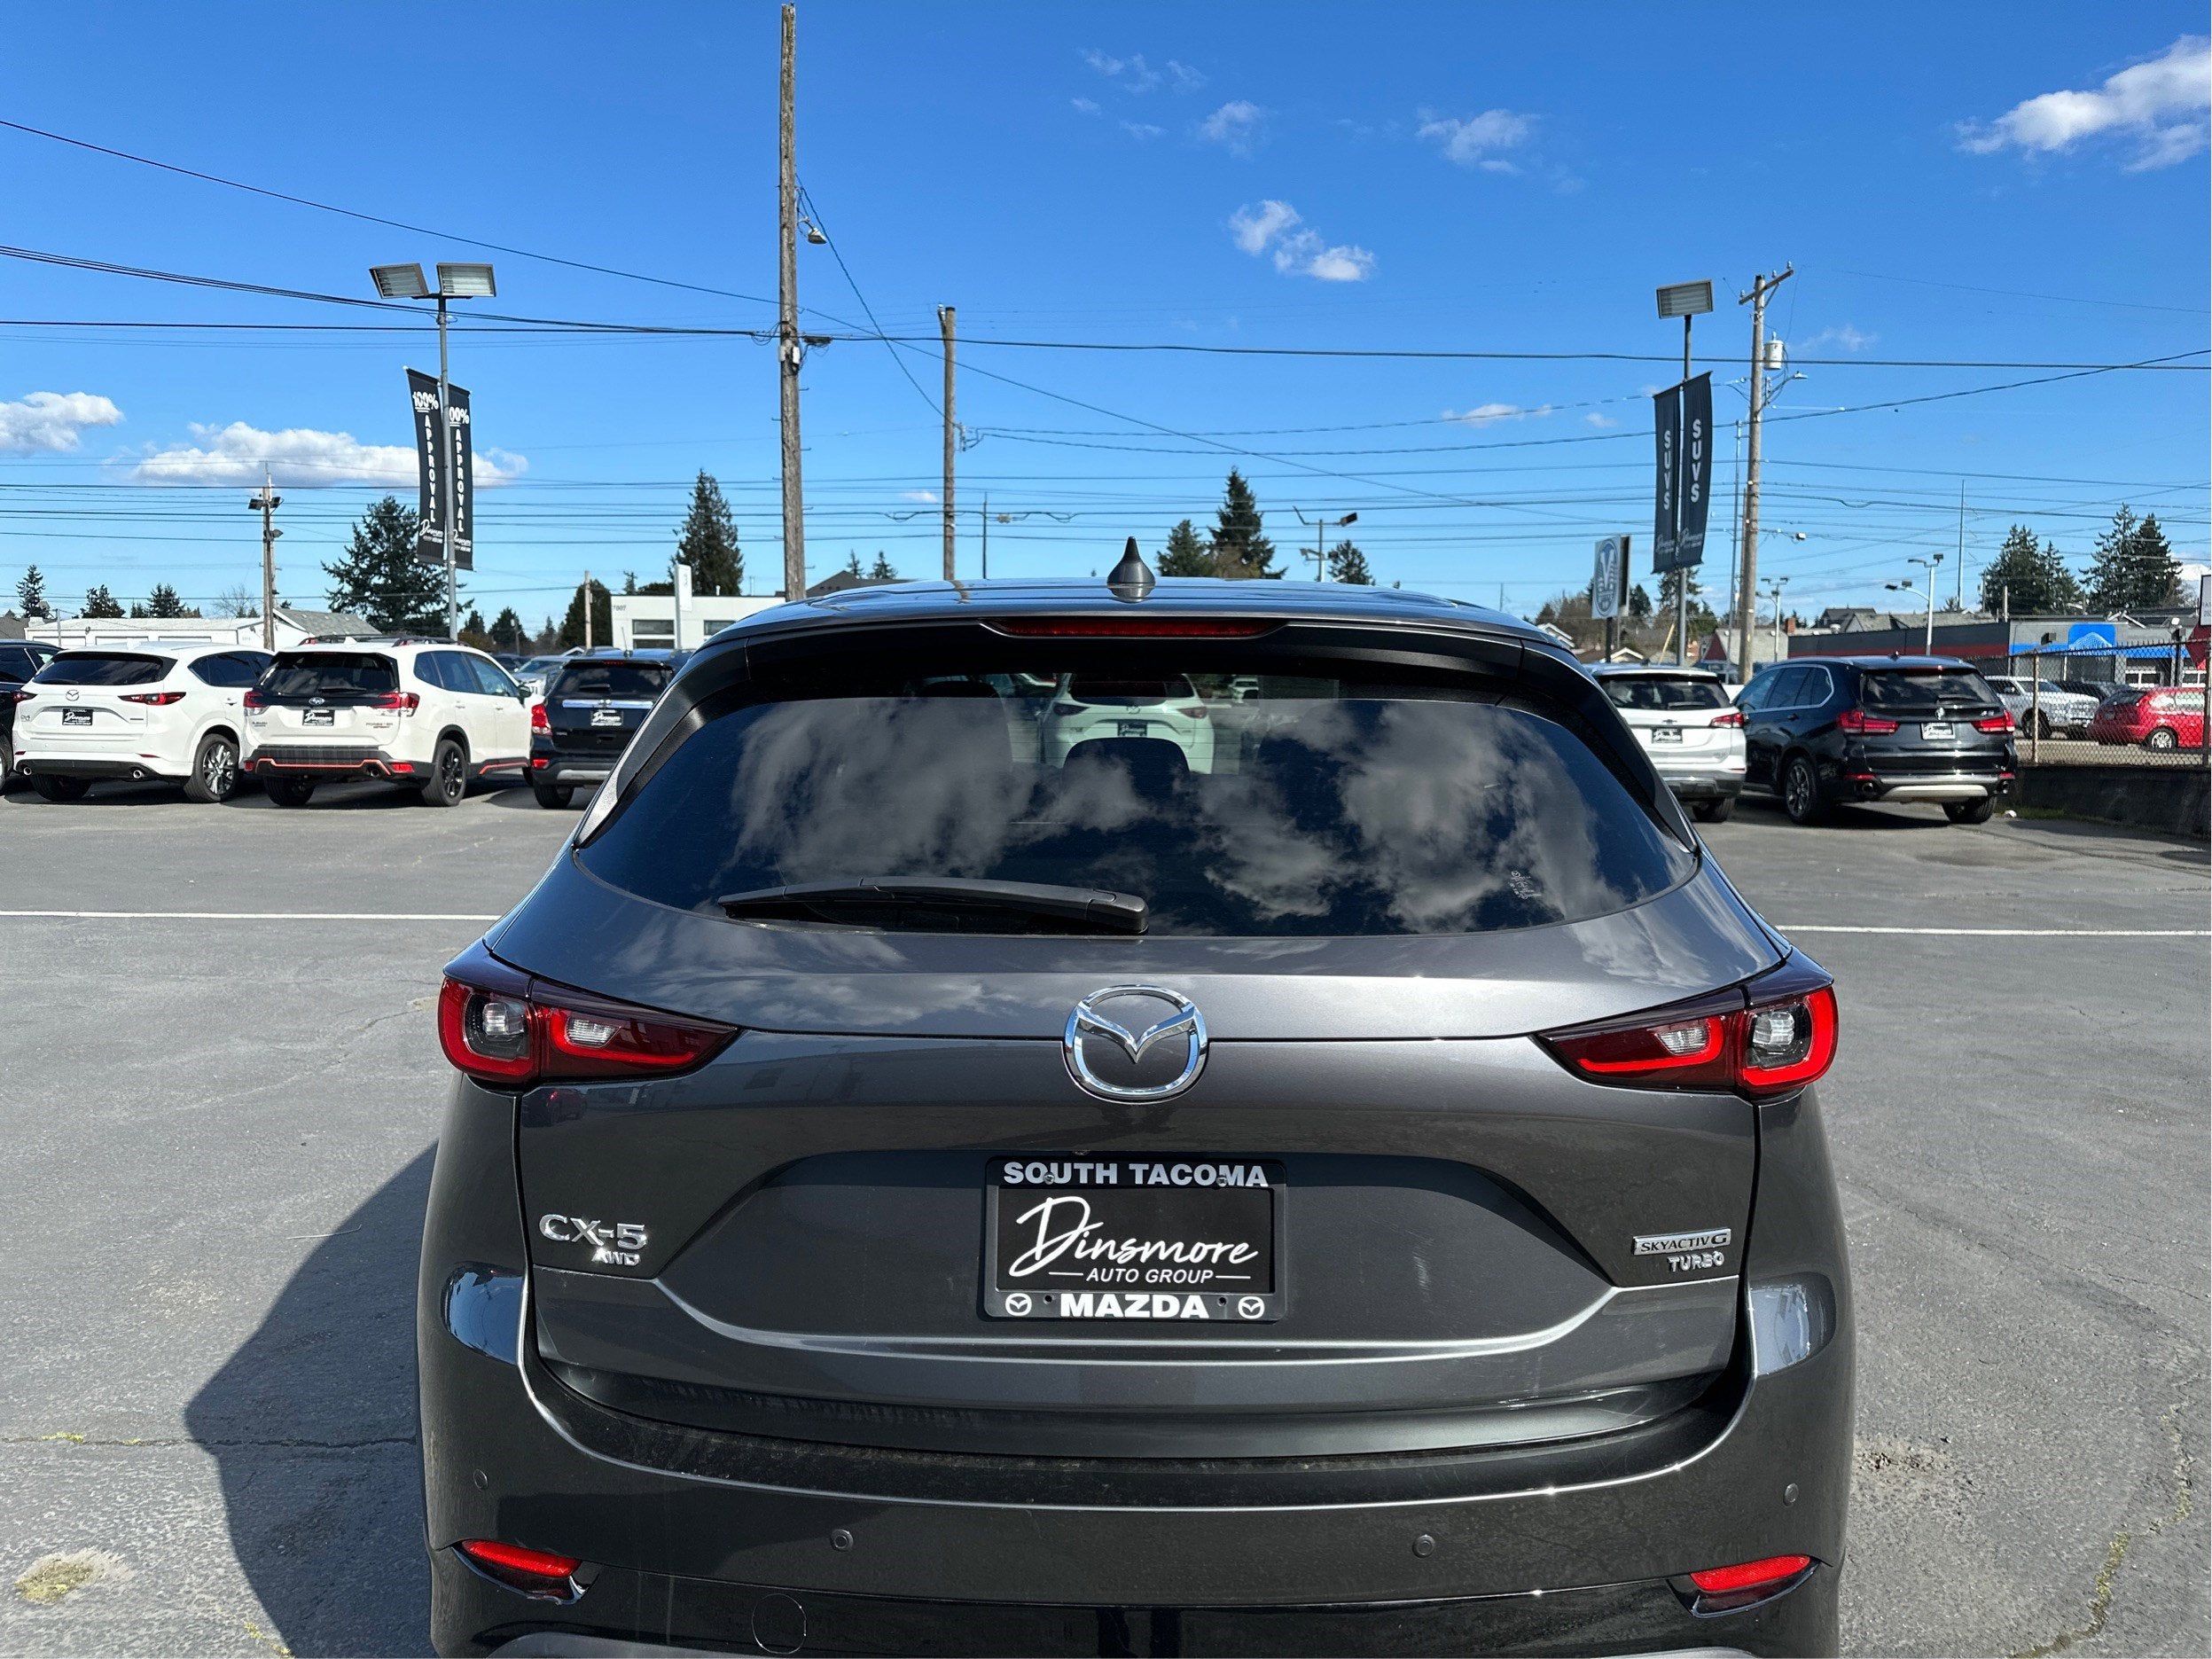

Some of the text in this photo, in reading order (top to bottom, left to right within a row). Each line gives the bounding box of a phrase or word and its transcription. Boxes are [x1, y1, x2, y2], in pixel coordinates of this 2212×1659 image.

[412, 391, 439, 410] 100%
[449, 406, 470, 425] 00%
[425, 414, 435, 523] APPROVAL
[1663, 429, 1672, 511] SUVS
[1692, 419, 1702, 503] SUVS
[456, 428, 465, 532] APPROVAL
[1004, 1162, 1269, 1187] SOUTH TACOMA
[539, 1214, 648, 1249] CX-5
[1008, 1195, 1259, 1278] Dinsmore
[590, 1247, 641, 1266] AWD
[1668, 1251, 1724, 1272] TURBO
[1085, 1268, 1214, 1284] AUTO GROUP
[1059, 1293, 1209, 1319] MAZDA
